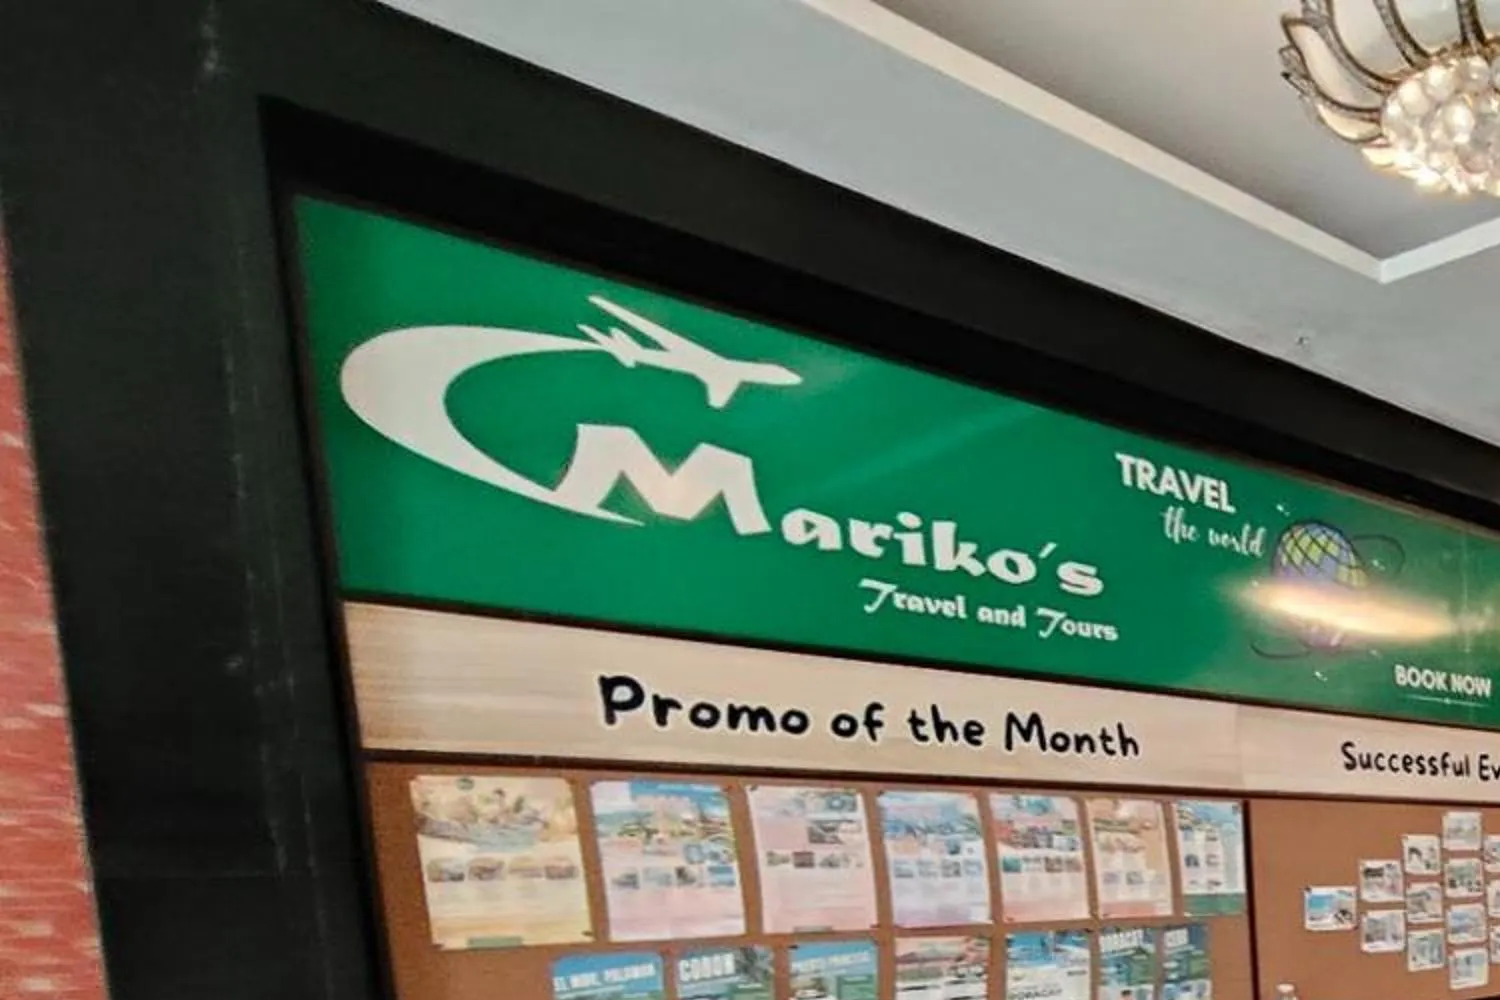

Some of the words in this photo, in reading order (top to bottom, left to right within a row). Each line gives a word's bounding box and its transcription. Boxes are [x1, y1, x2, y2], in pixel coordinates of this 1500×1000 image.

[1114, 452, 1237, 515] TRAVEL
[1160, 505, 1199, 545] the
[1208, 520, 1267, 559] world
[858, 578, 967, 620] Travel
[977, 604, 1027, 629] and
[1035, 607, 1119, 641] Tours
[1395, 664, 1448, 692] BOOK
[1451, 673, 1493, 698] NOW
[597, 675, 811, 735] Promo
[830, 702, 884, 742] of
[908, 703, 986, 747] the
[1005, 711, 1140, 757] Month
[1340, 741, 1471, 777] Successful
